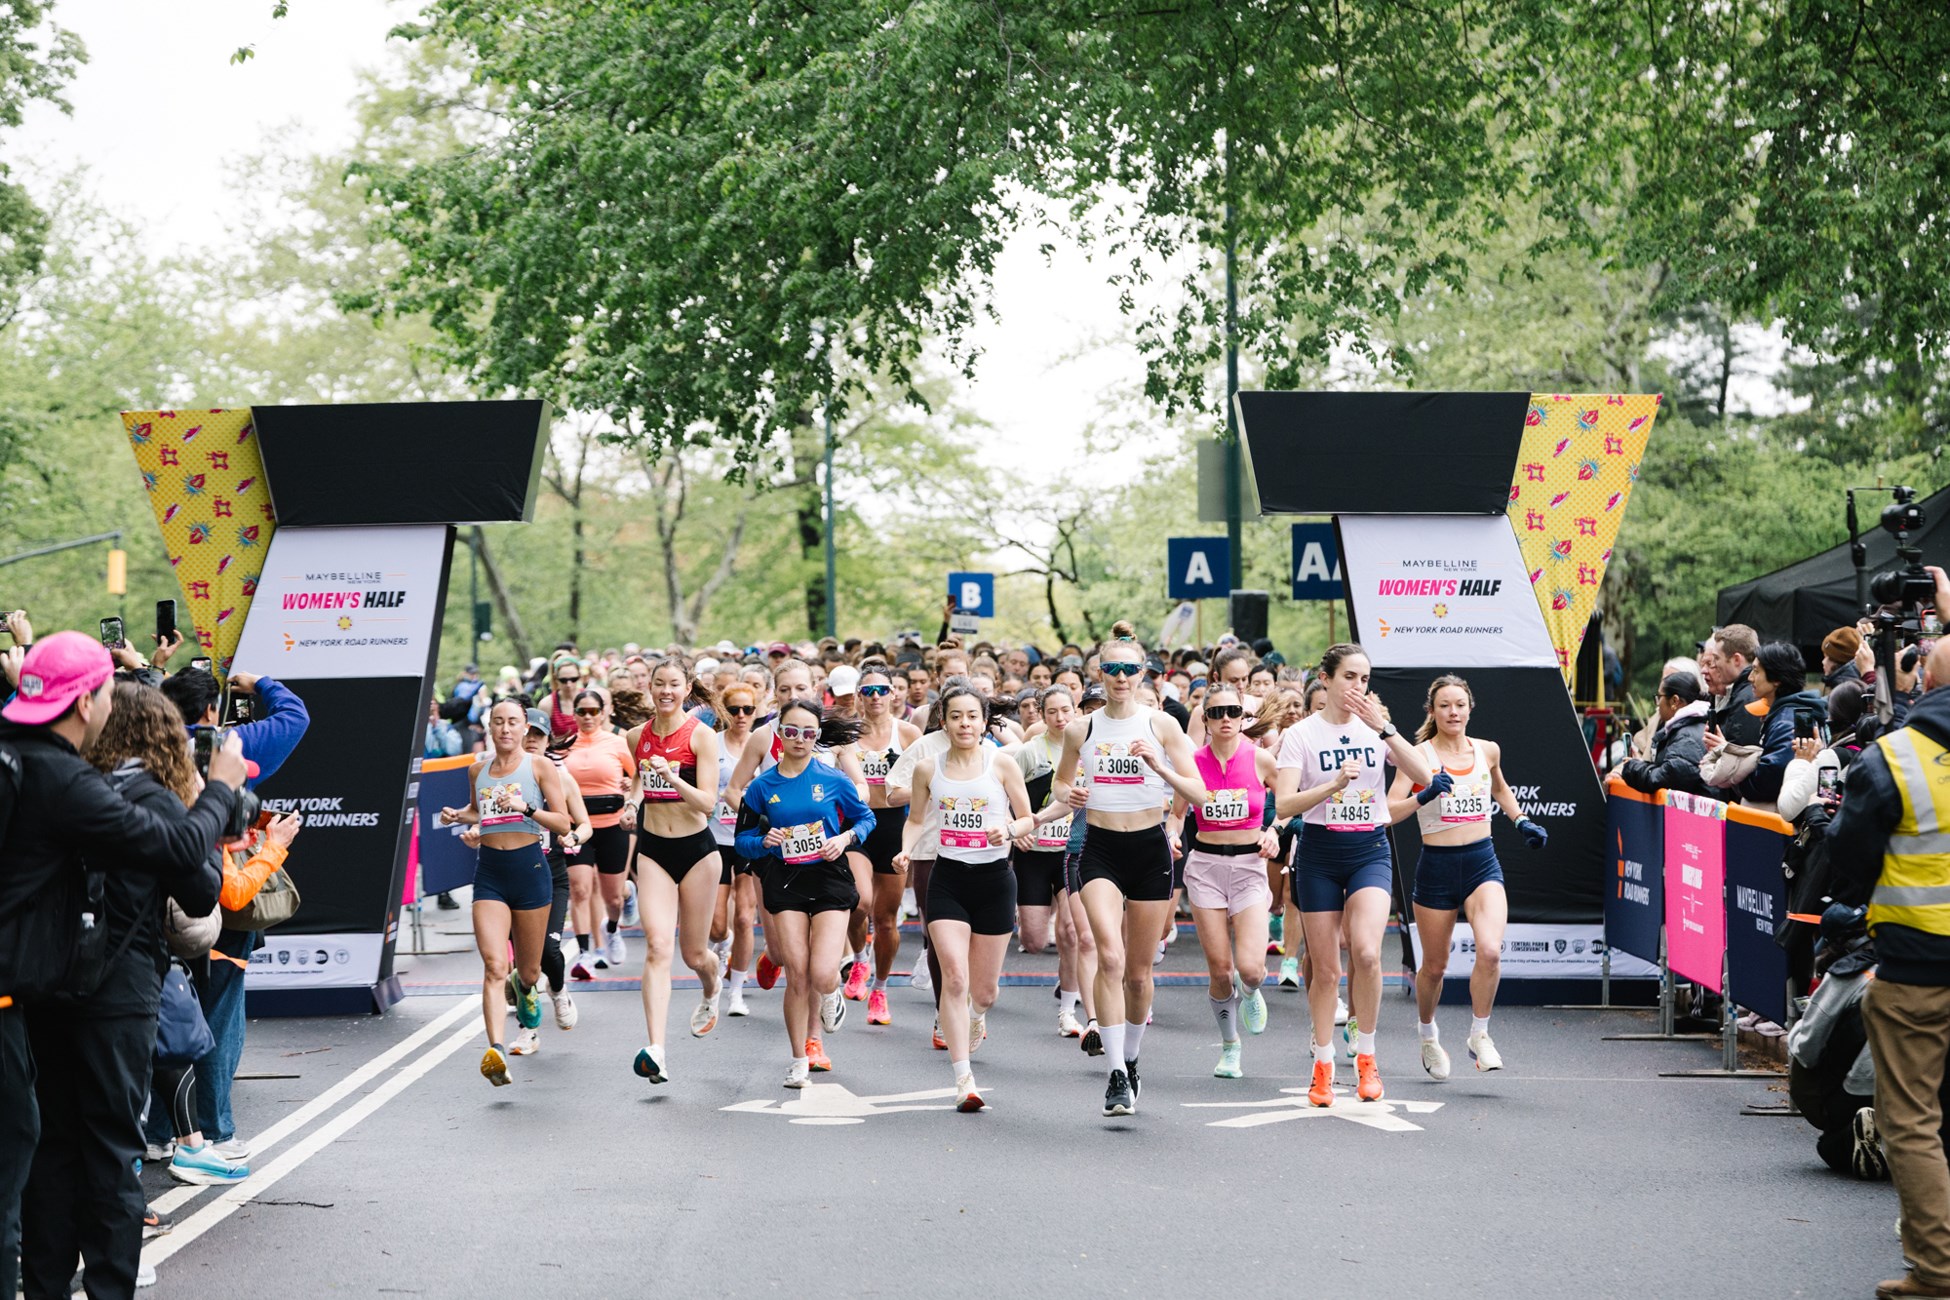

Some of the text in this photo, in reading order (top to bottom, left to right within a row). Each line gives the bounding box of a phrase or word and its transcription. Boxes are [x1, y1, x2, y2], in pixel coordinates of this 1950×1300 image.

[1184, 551, 1214, 585] A
[1296, 542, 1342, 582] A
[1402, 560, 1478, 568] MAYBELLINE
[305, 571, 382, 581] MAYBELLINE
[961, 581, 982, 609] B
[1378, 579, 1502, 596] WOMEN'S HALF
[282, 590, 406, 610] WOMEN'S HALF
[1394, 626, 1504, 634] NEW YORK ROAD RUNNERS
[298, 637, 409, 647] NEW YORK ROAD RUNNERS
[1107, 758, 1139, 774] 3096
[1319, 747, 1376, 772] CPTC
[863, 763, 888, 776] 4343
[649, 774, 673, 789] 502
[1509, 785, 1541, 800] ORK
[261, 797, 343, 811] NEW YORK
[1455, 798, 1482, 814] 3235
[1518, 802, 1576, 817] NNERS
[305, 812, 380, 827] RUNNERS
[952, 813, 983, 829] 4959
[1340, 806, 1370, 821] 4845
[793, 836, 823, 854] 3055
[1736, 884, 1774, 920] MAYBELLINE
